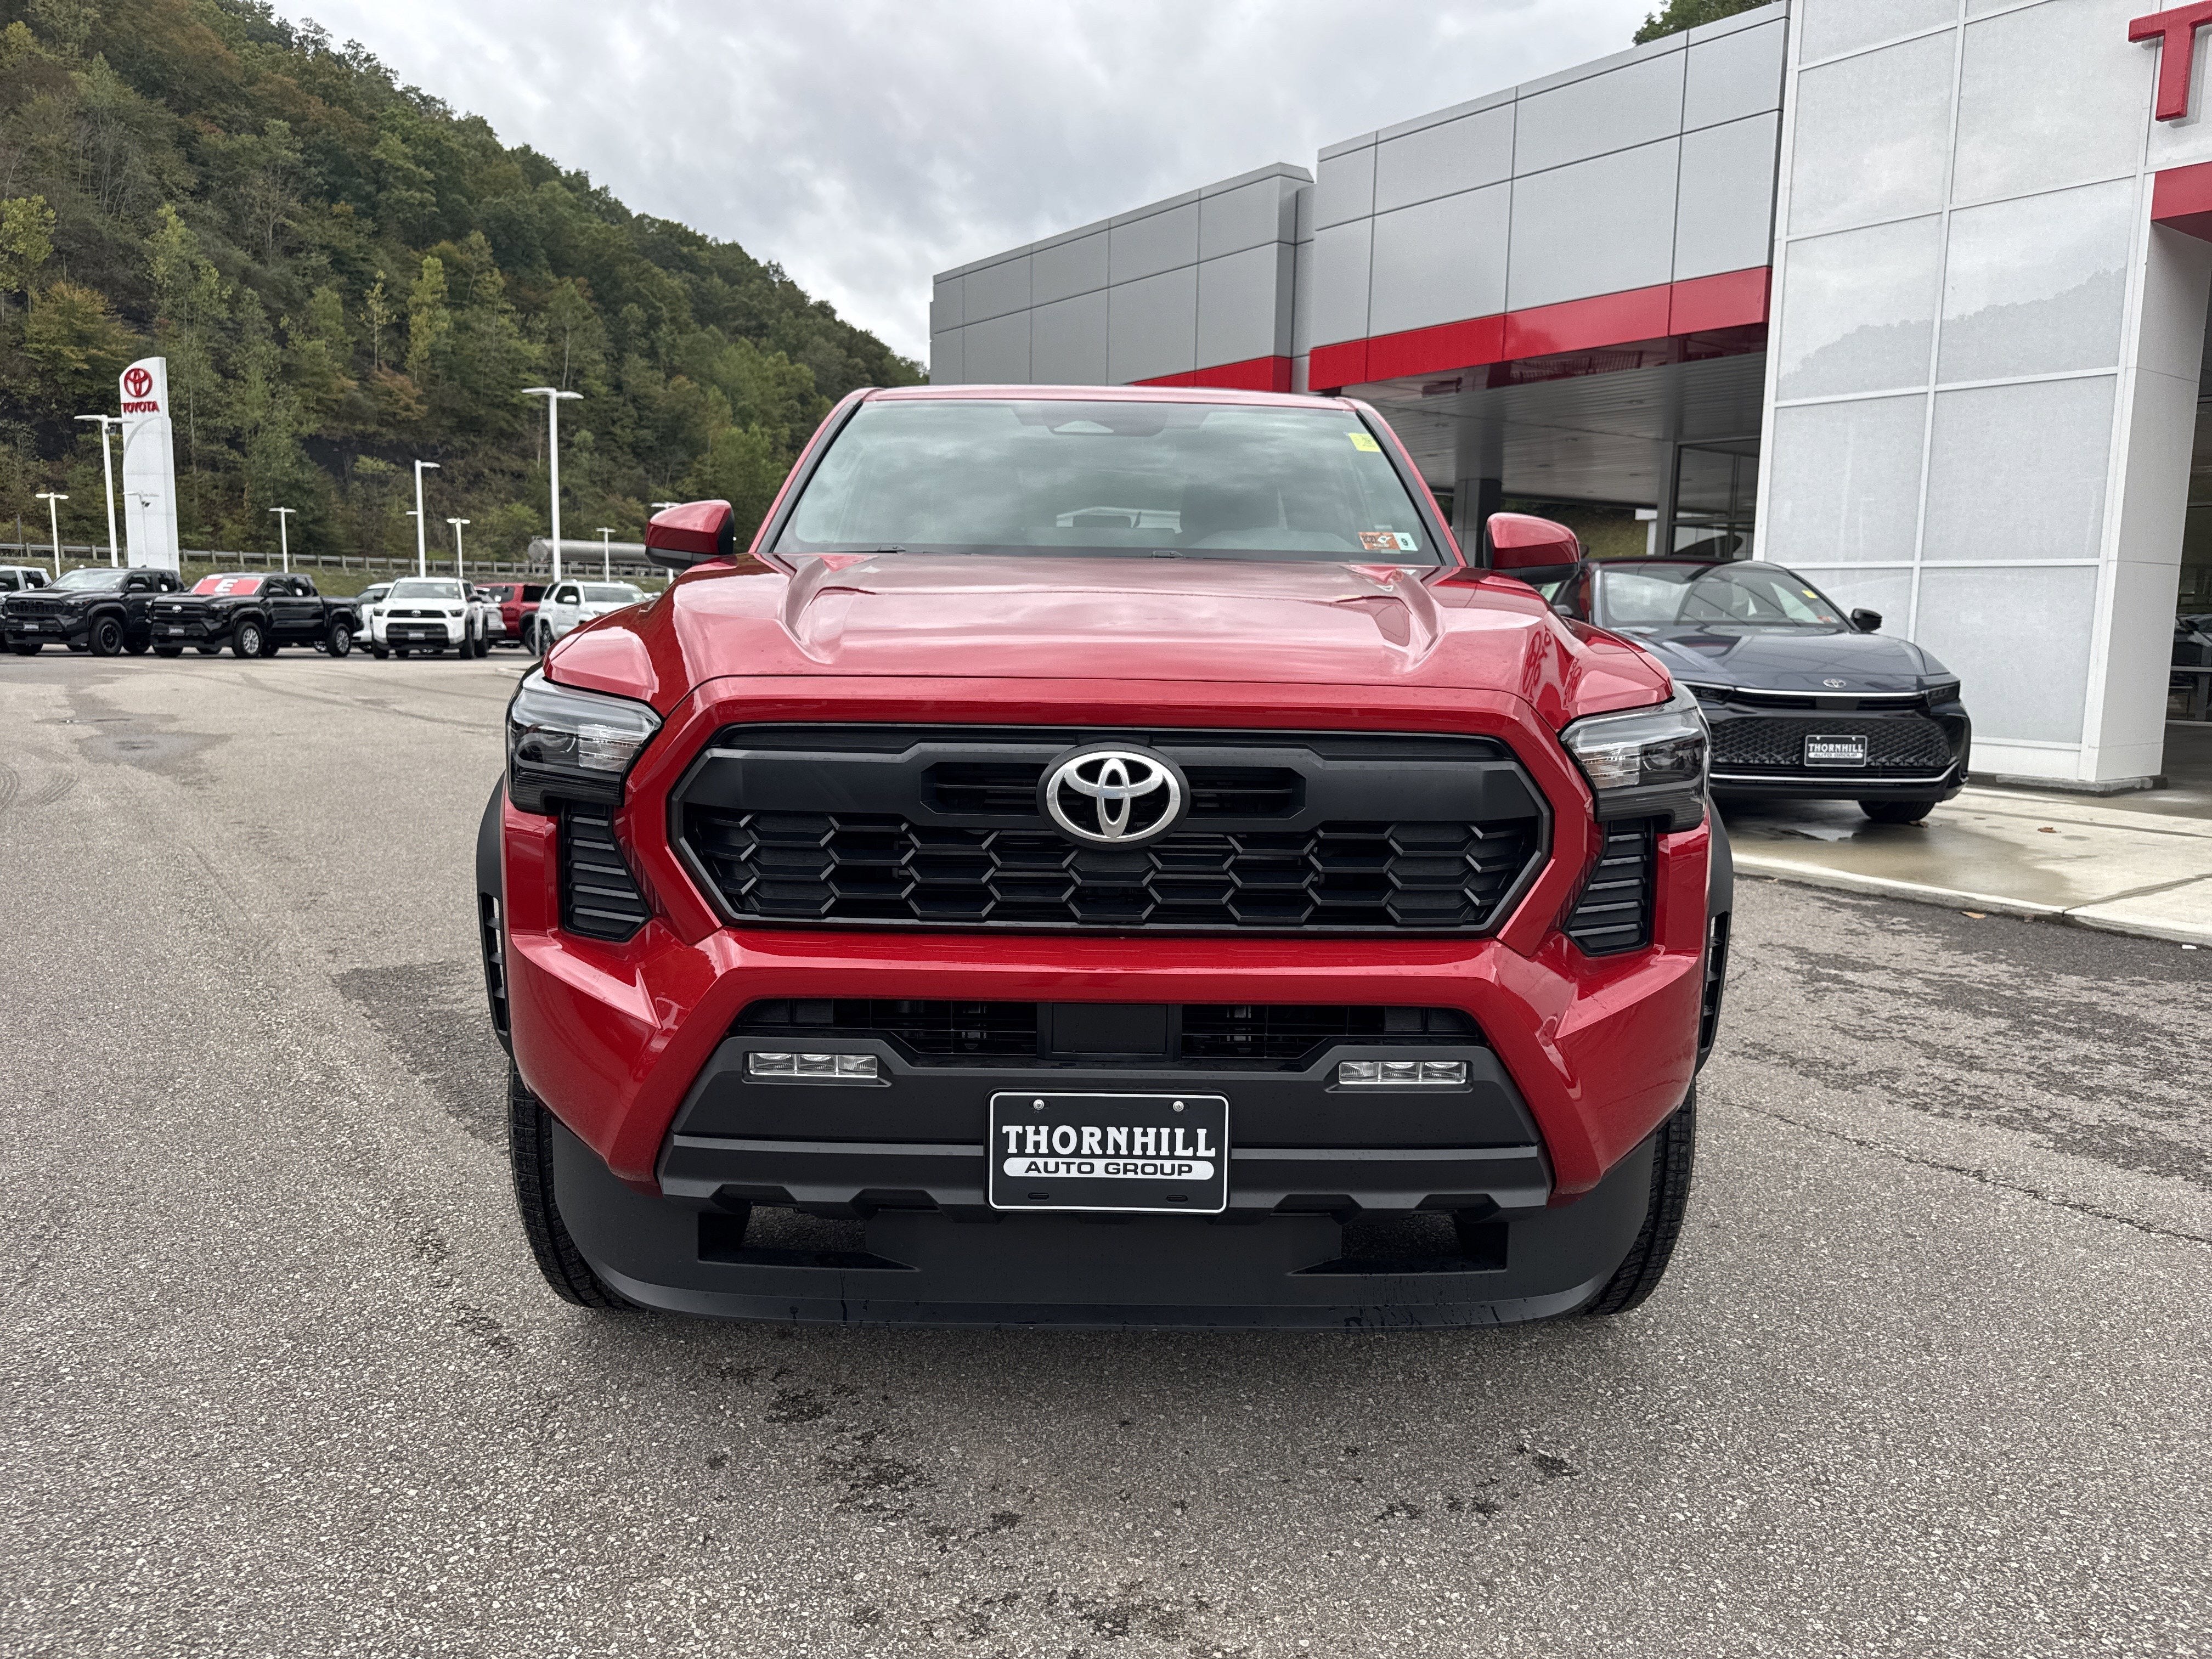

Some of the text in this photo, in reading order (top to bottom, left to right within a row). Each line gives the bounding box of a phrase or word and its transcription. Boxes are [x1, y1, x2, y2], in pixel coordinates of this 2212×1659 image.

[121, 400, 160, 413] TOYOTA
[1808, 743, 1864, 752] THORNHILL
[1002, 1125, 1215, 1157] THORNHILL
[1024, 1161, 1193, 1176] AUTO GROUP
